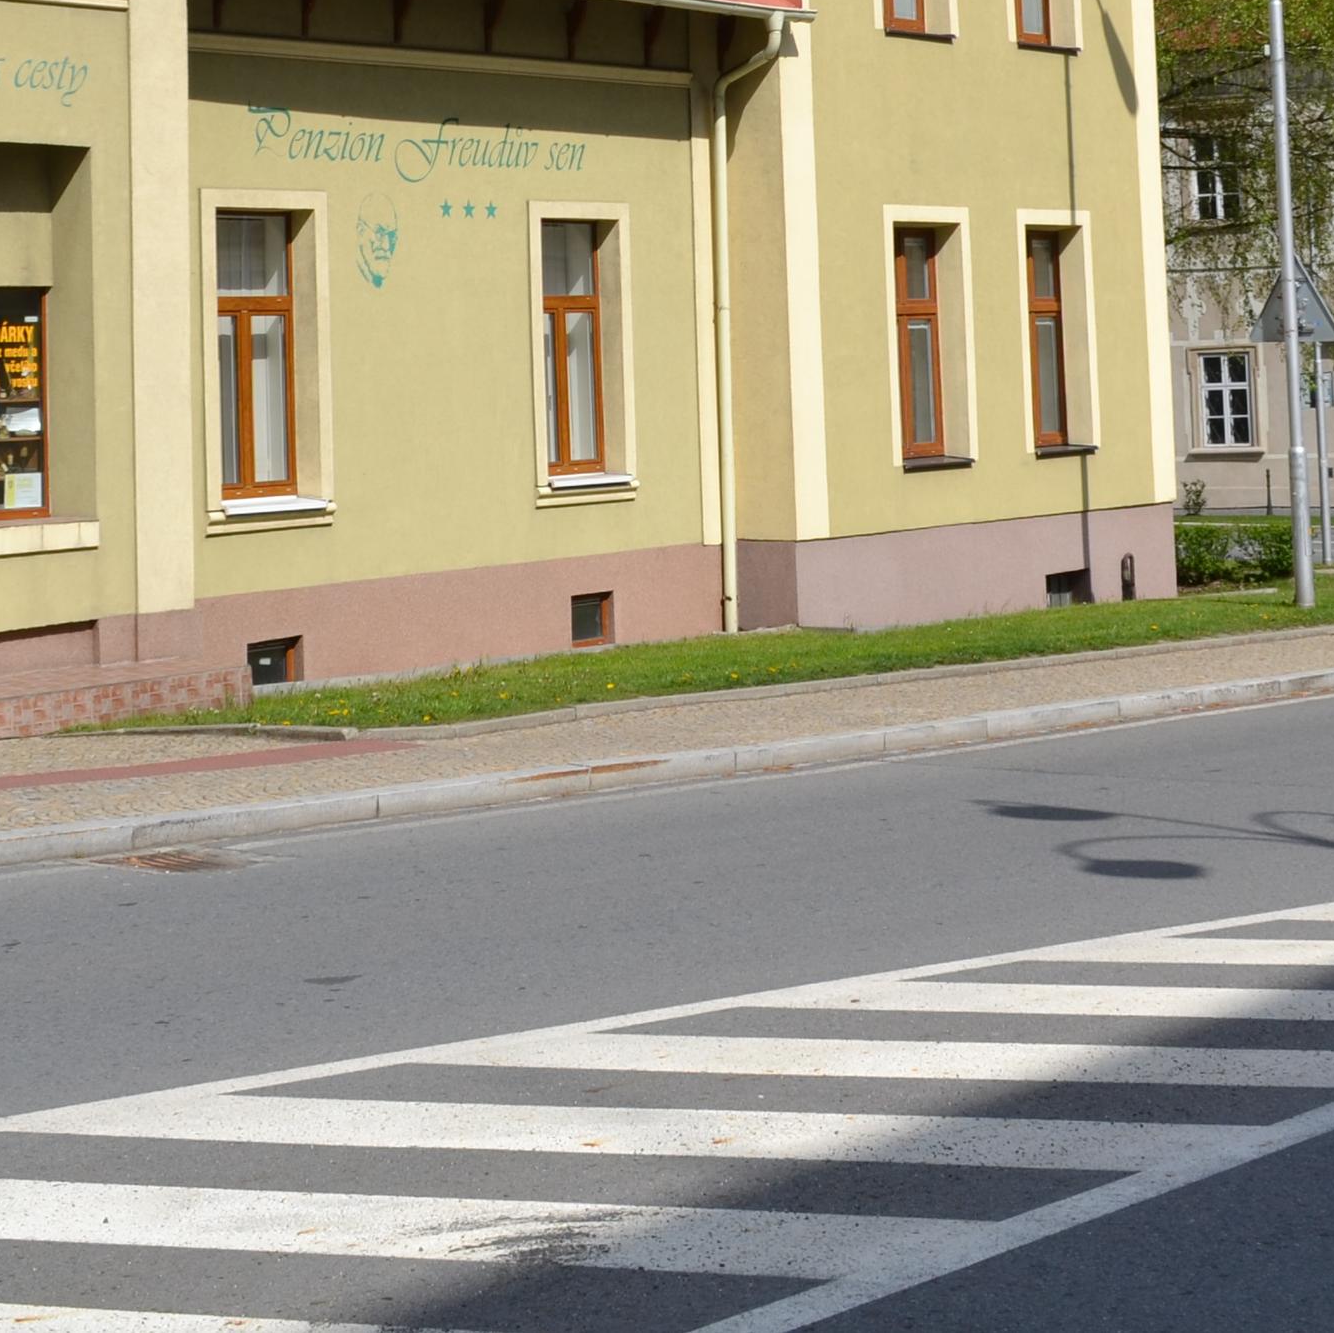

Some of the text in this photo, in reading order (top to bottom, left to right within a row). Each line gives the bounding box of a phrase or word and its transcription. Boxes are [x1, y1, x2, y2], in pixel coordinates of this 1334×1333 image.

[13, 55, 89, 108] cesty
[248, 101, 587, 184] Penzion Freudův sen
